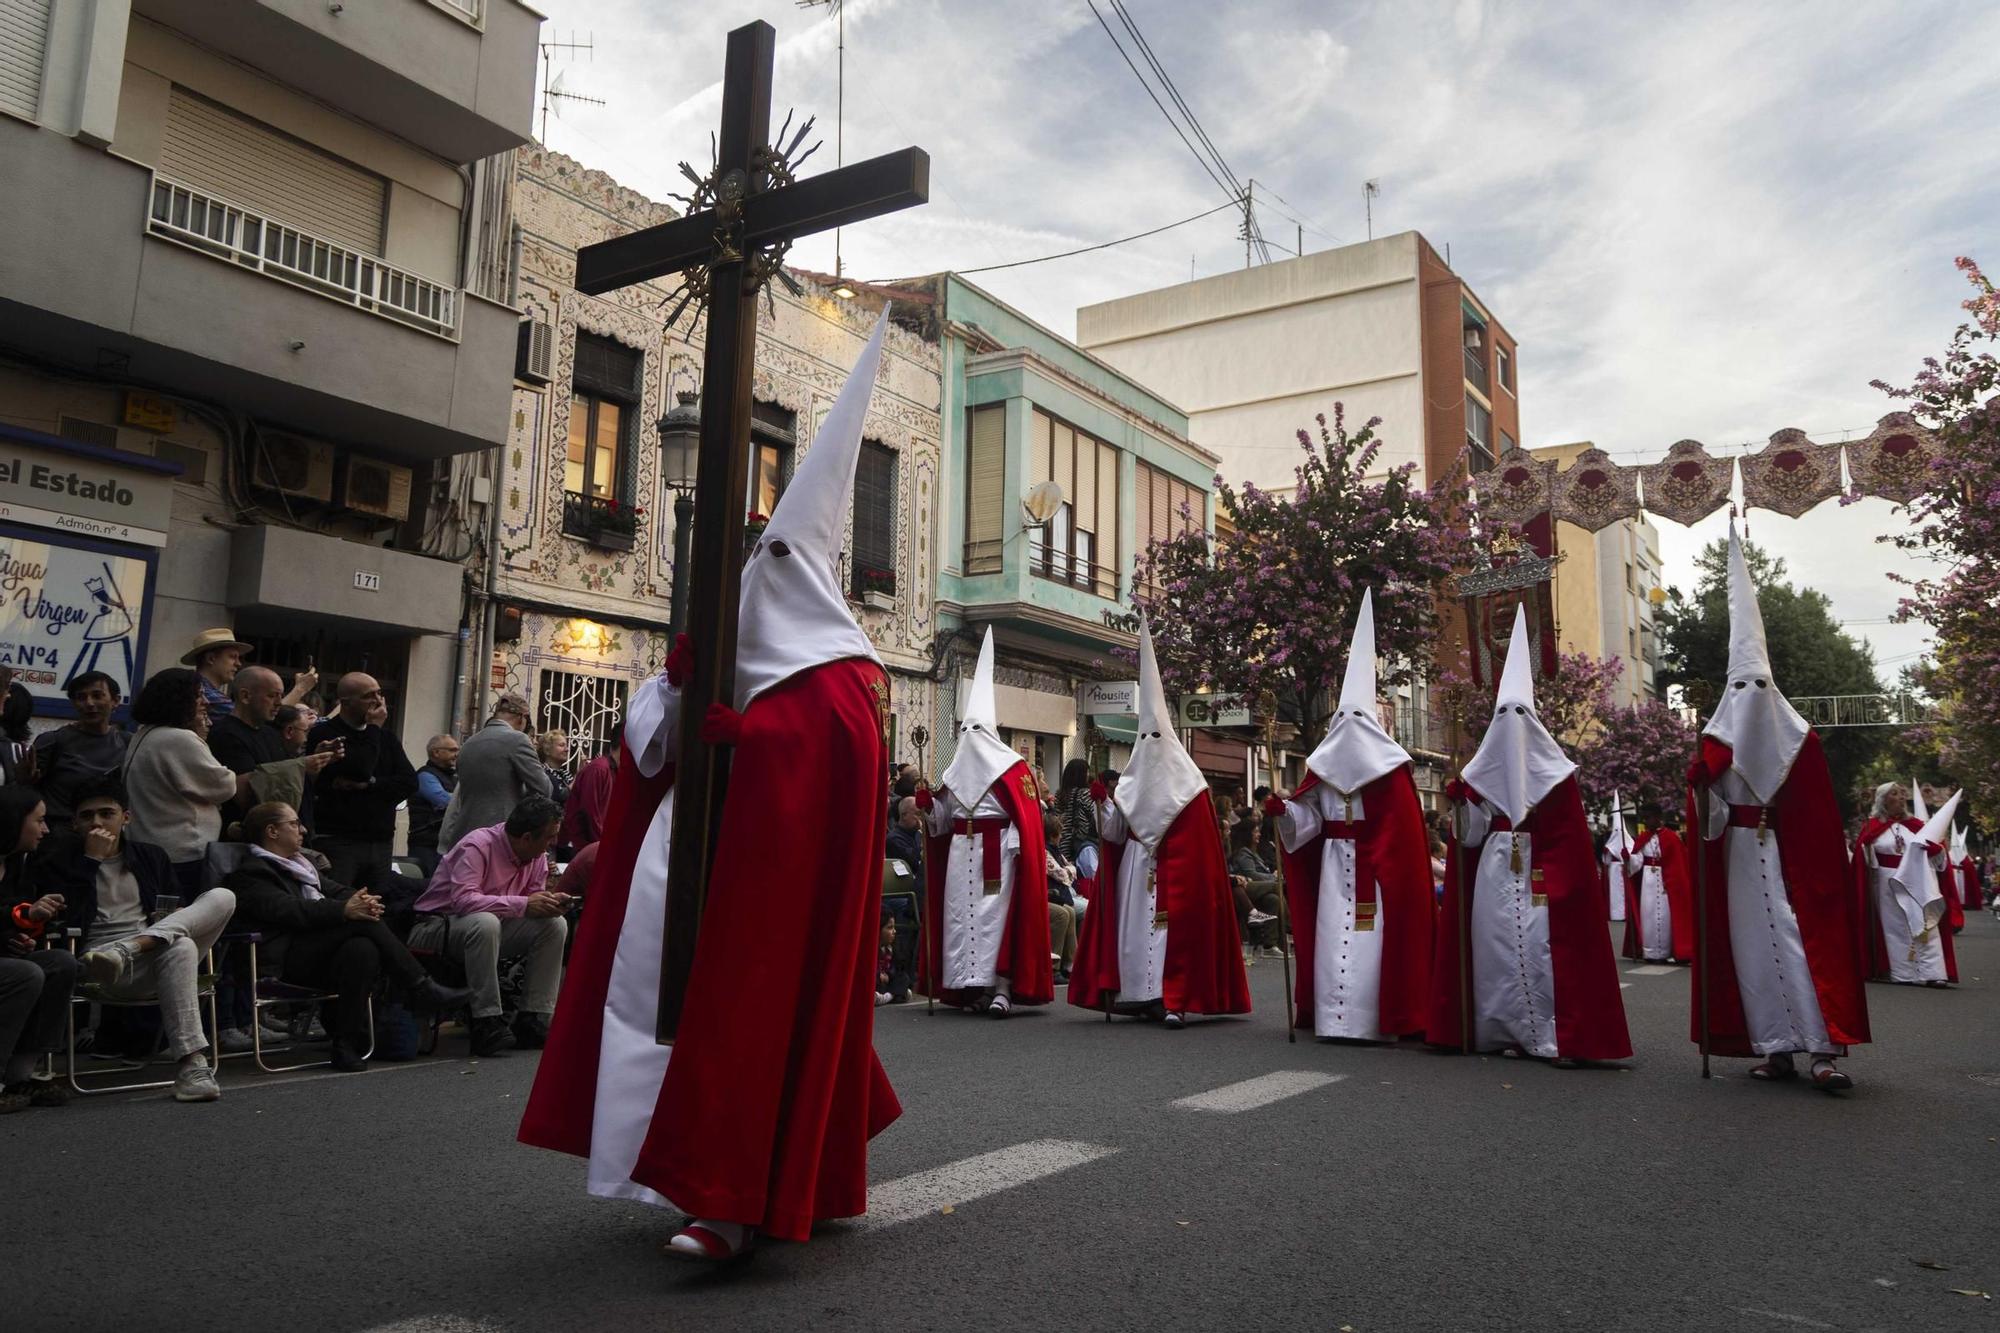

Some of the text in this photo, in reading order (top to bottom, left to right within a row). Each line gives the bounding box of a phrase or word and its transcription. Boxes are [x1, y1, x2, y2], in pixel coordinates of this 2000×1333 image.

[30, 464, 134, 506] Estado
[121, 528, 129, 537] 4
[356, 573, 378, 589] 171
[13, 586, 89, 636] Virgen
[18, 645, 59, 668] Nº4
[1093, 690, 1130, 701] Housite
[1218, 710, 1244, 718] OGADOS
